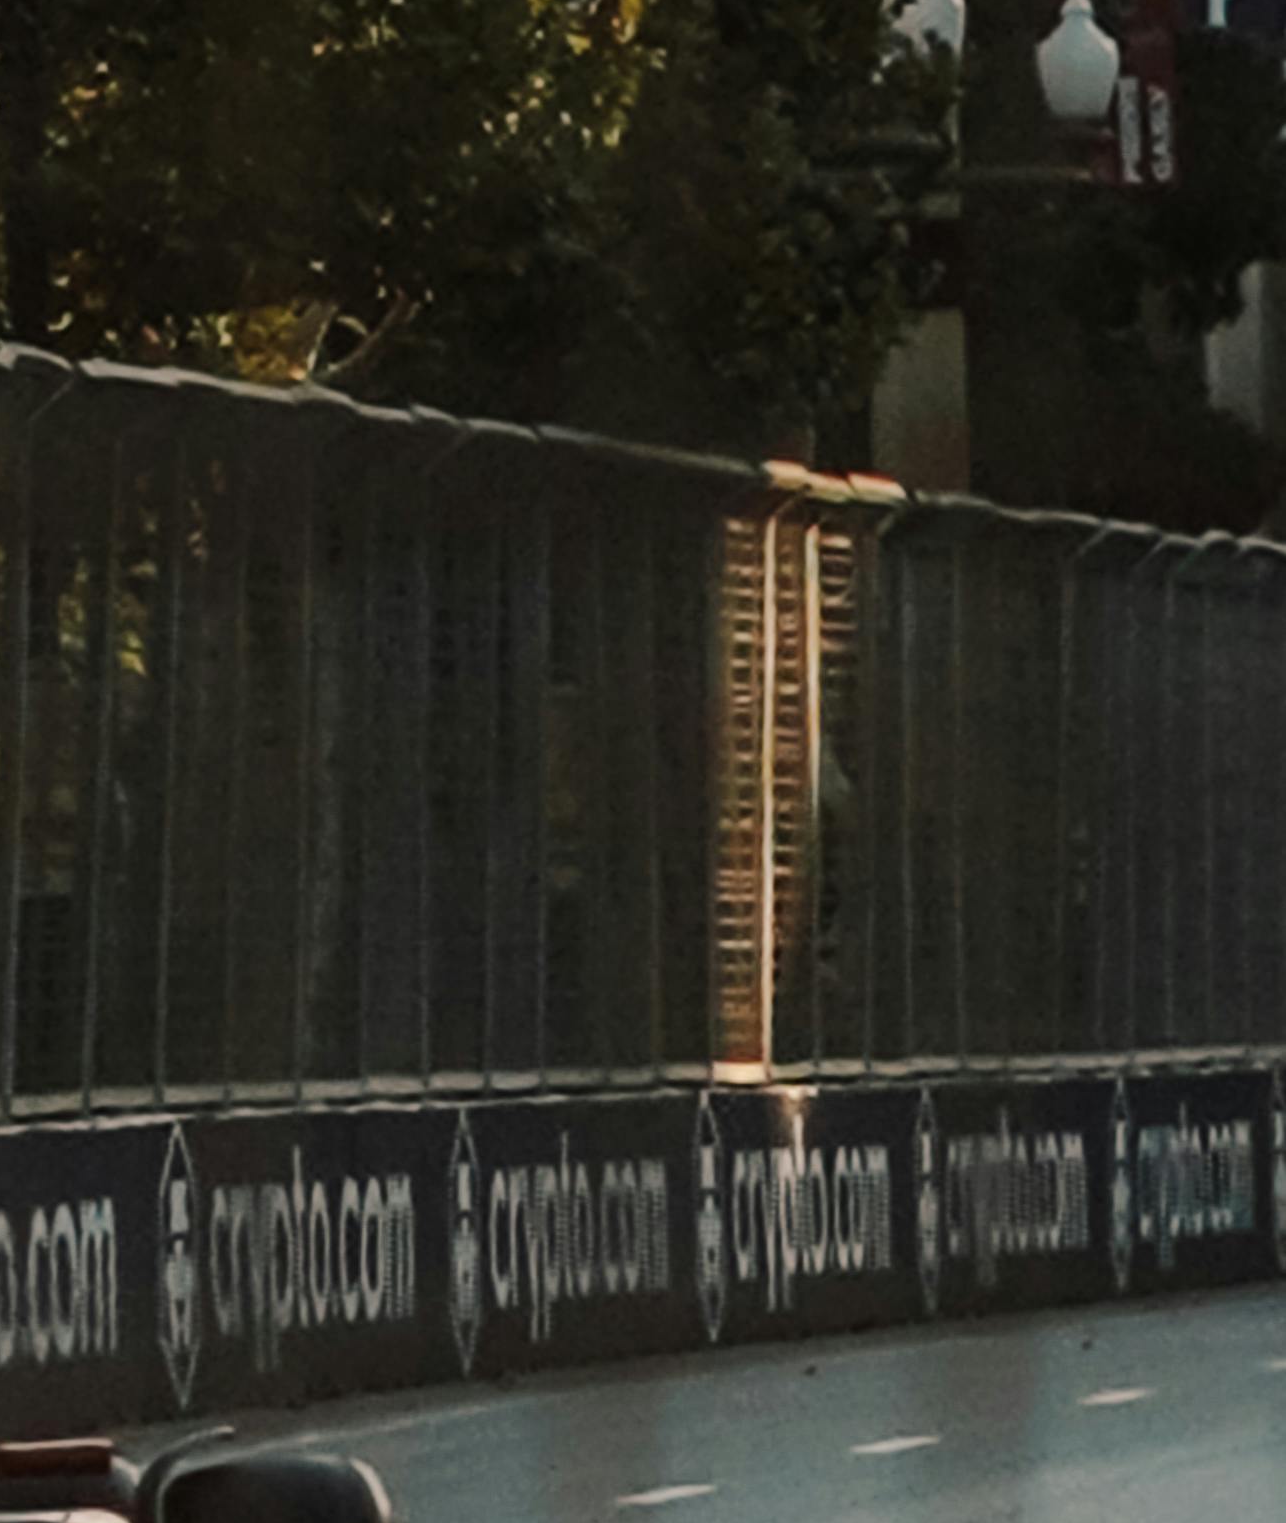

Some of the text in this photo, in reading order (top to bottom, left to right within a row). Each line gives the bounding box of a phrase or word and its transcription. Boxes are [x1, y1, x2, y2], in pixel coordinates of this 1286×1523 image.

[211, 1144, 413, 1374] crypto.com
[489, 1130, 669, 1342] crypto.com
[732, 1112, 892, 1314] crypto.com
